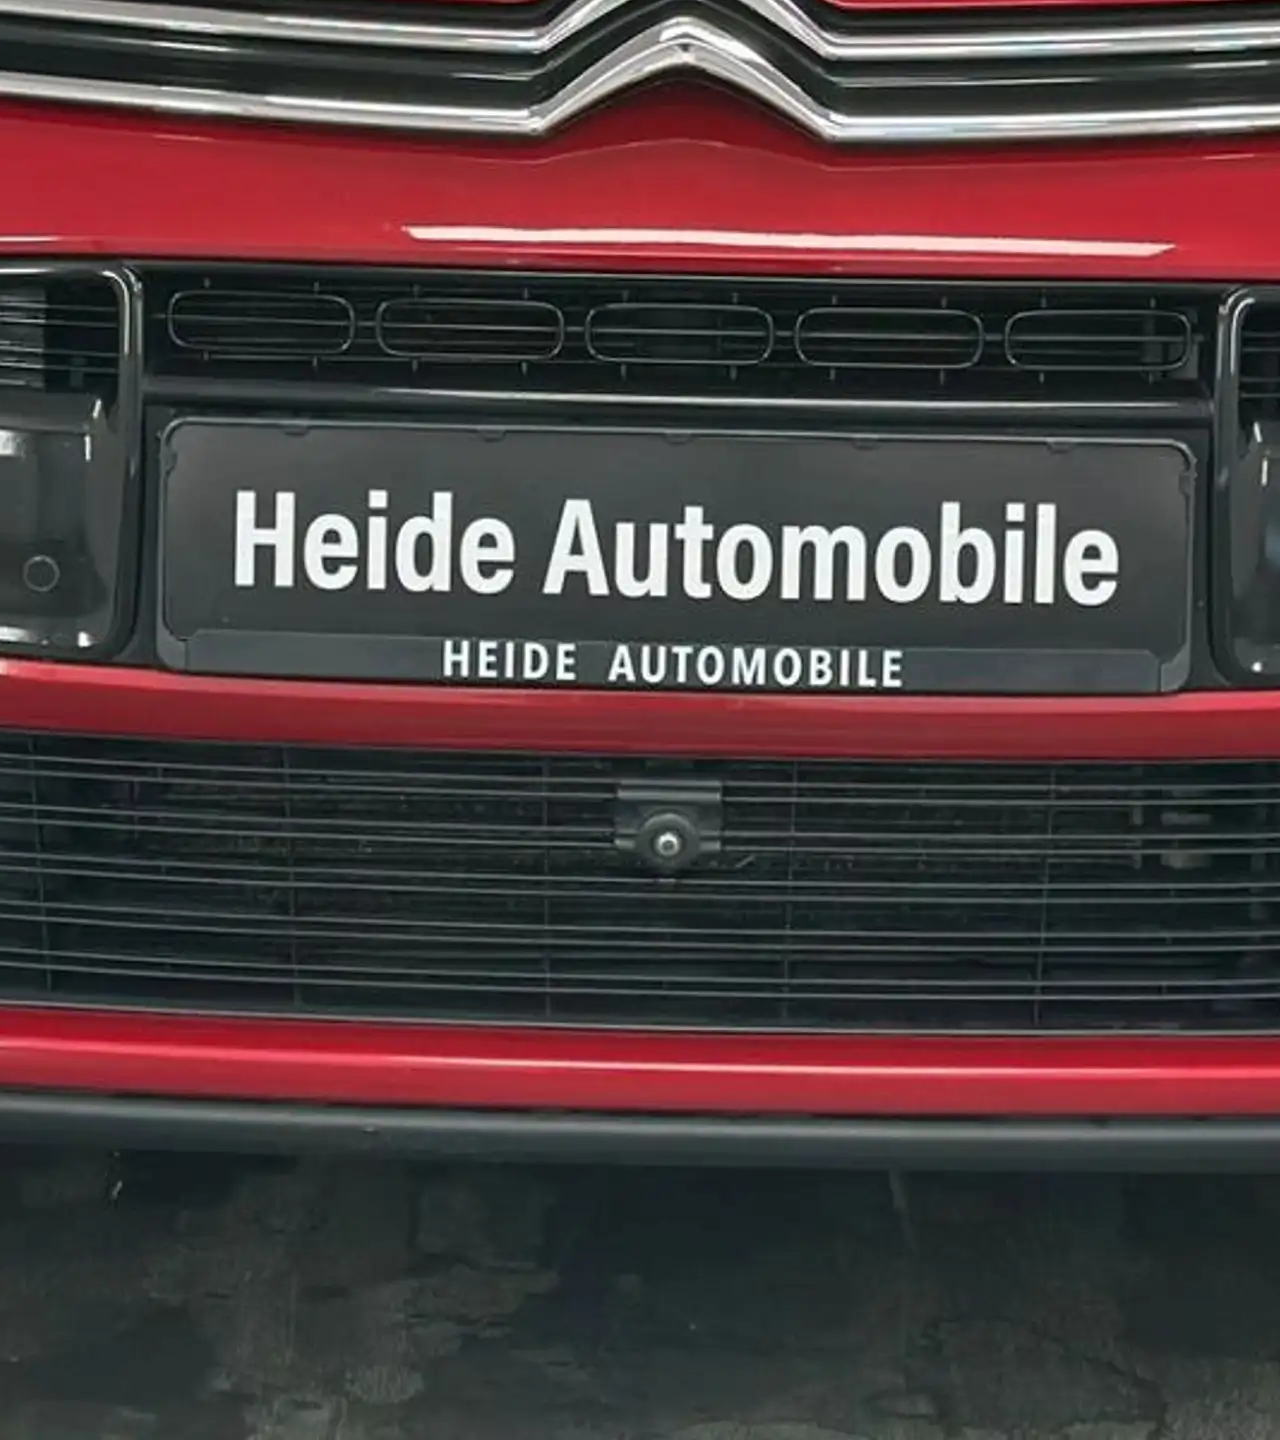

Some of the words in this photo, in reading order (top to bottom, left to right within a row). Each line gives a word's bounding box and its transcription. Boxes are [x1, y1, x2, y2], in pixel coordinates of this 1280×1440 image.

[234, 489, 516, 594] Heide
[542, 498, 1120, 606] Automobile
[443, 638, 577, 681] HEIDE
[607, 643, 903, 688] AUTOMOBILE
